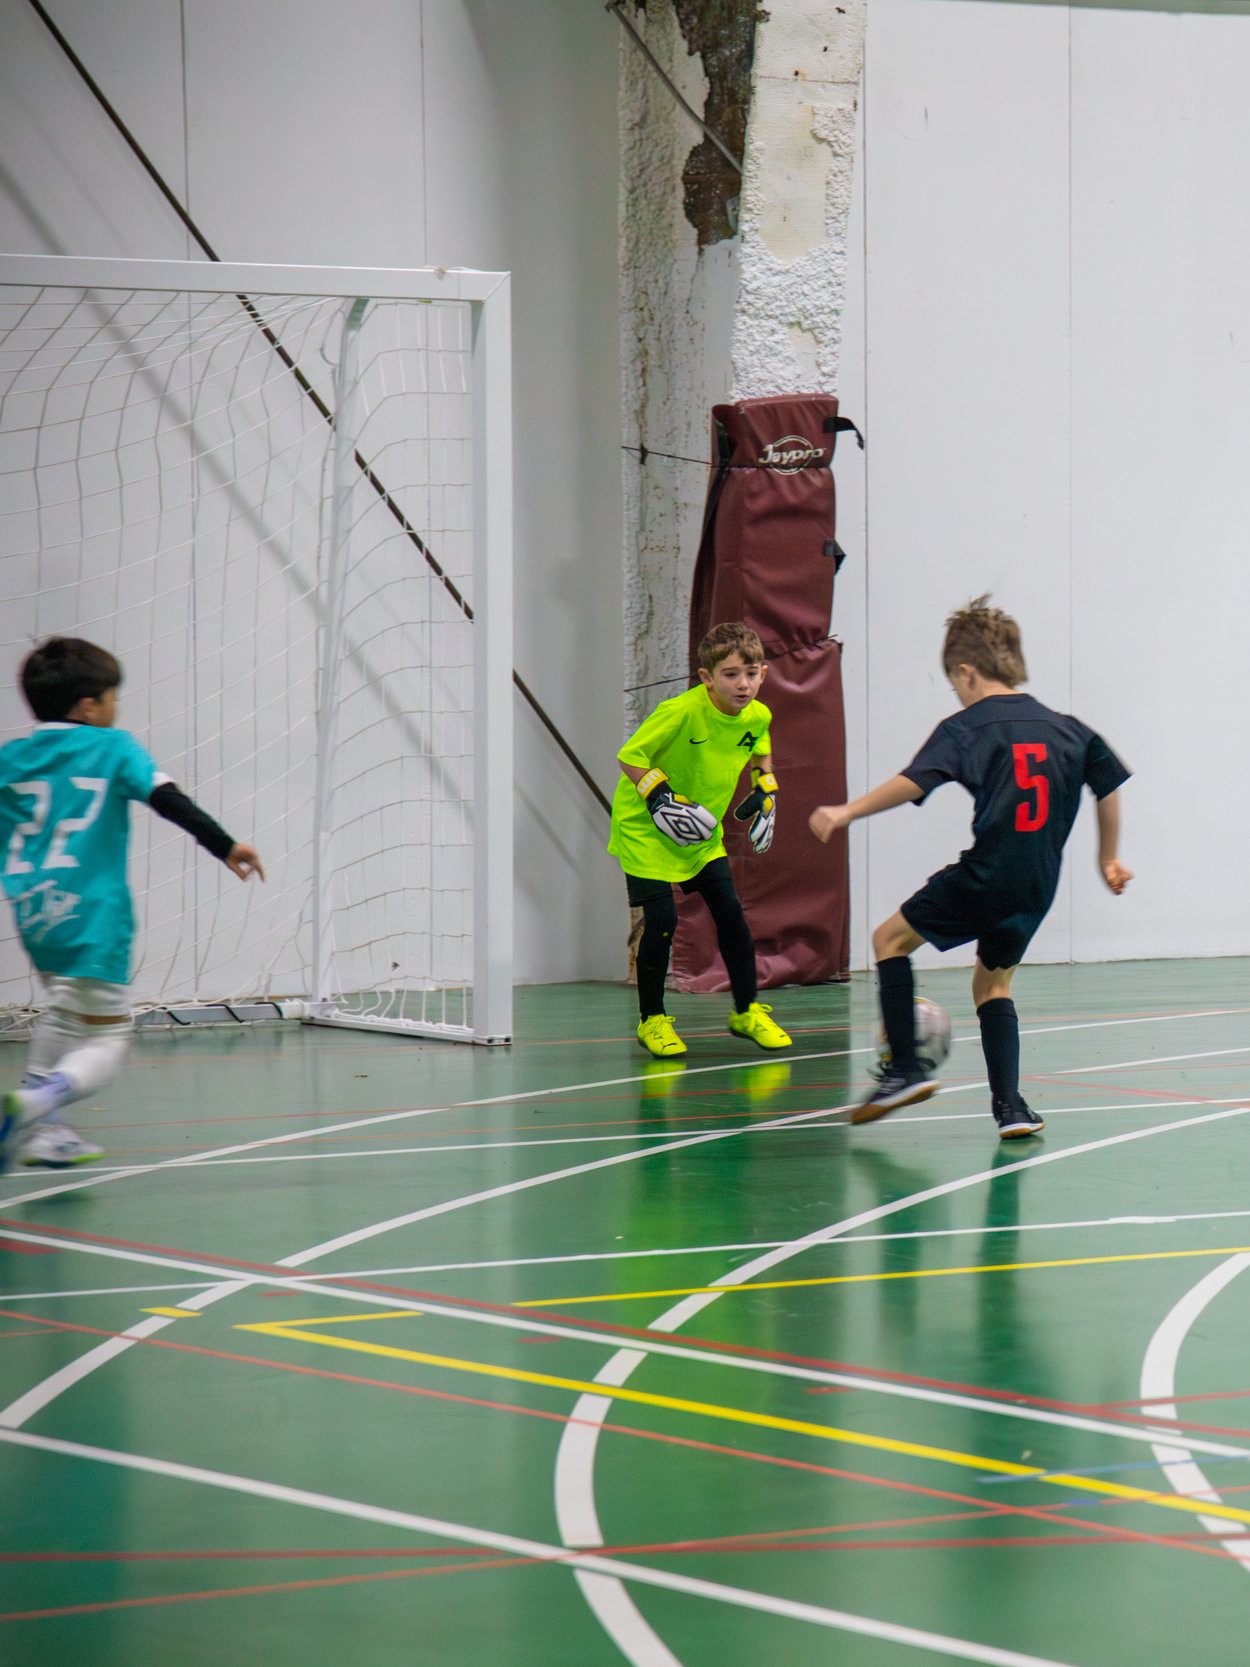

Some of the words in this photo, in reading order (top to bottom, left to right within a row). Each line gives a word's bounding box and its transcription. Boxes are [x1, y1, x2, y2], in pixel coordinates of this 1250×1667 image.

[758, 444, 824, 465] Jaypro
[3, 776, 110, 876] 22
[1012, 743, 1050, 832] 5
